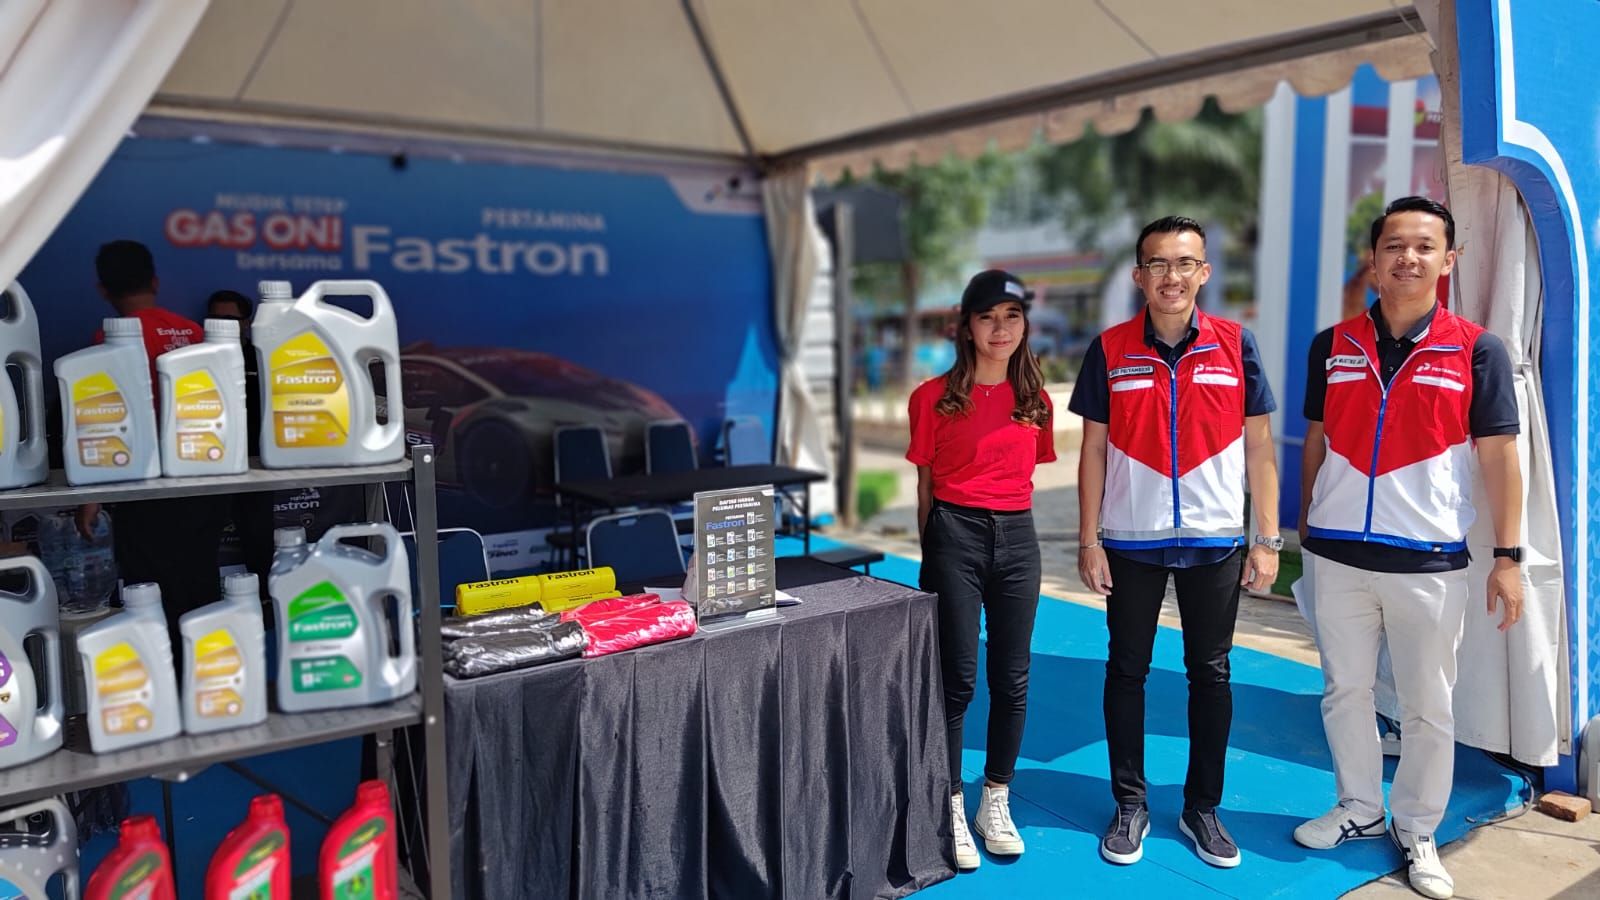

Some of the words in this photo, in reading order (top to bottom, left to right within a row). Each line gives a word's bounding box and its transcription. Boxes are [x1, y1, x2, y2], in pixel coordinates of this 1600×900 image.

[481, 208, 606, 231] PERTAMINA
[165, 209, 257, 247] GAS
[263, 213, 343, 249] ON!
[352, 225, 609, 275] Fastron
[237, 252, 342, 270] bersama
[276, 374, 336, 384] Fastron
[273, 501, 320, 511] astron
[705, 520, 745, 530] Fastron
[547, 569, 595, 580] Fastron
[467, 578, 519, 589] Fastron
